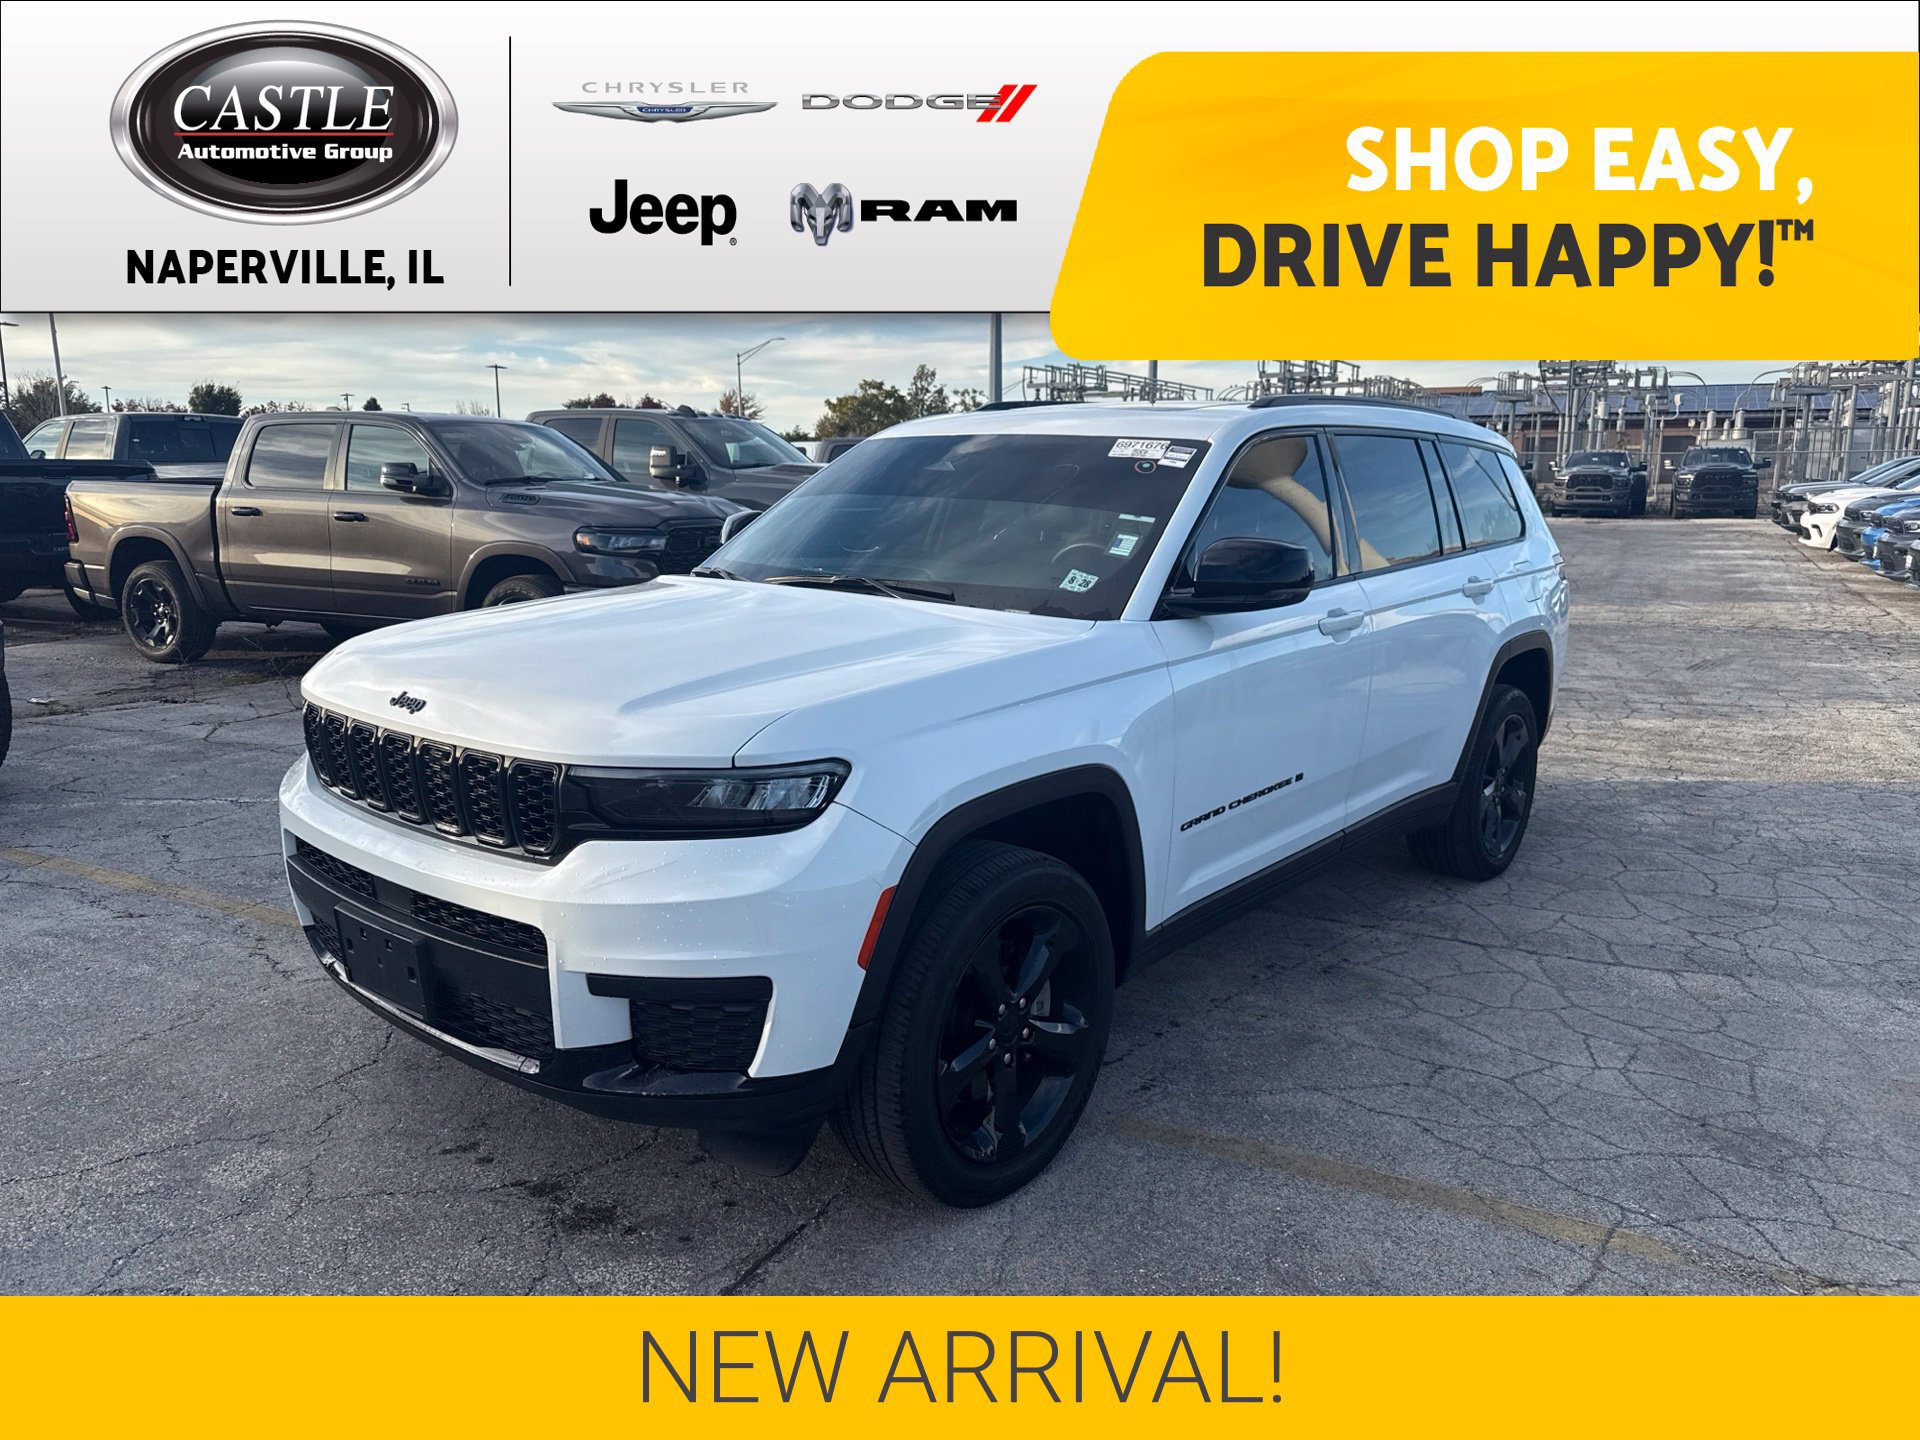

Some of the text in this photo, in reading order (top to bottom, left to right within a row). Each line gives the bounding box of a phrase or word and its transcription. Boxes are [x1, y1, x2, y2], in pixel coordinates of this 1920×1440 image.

[1116, 440, 1169, 450] 6971676
[389, 691, 427, 715] Jeep
[1180, 777, 1293, 832] GRAND CHEROKEE
